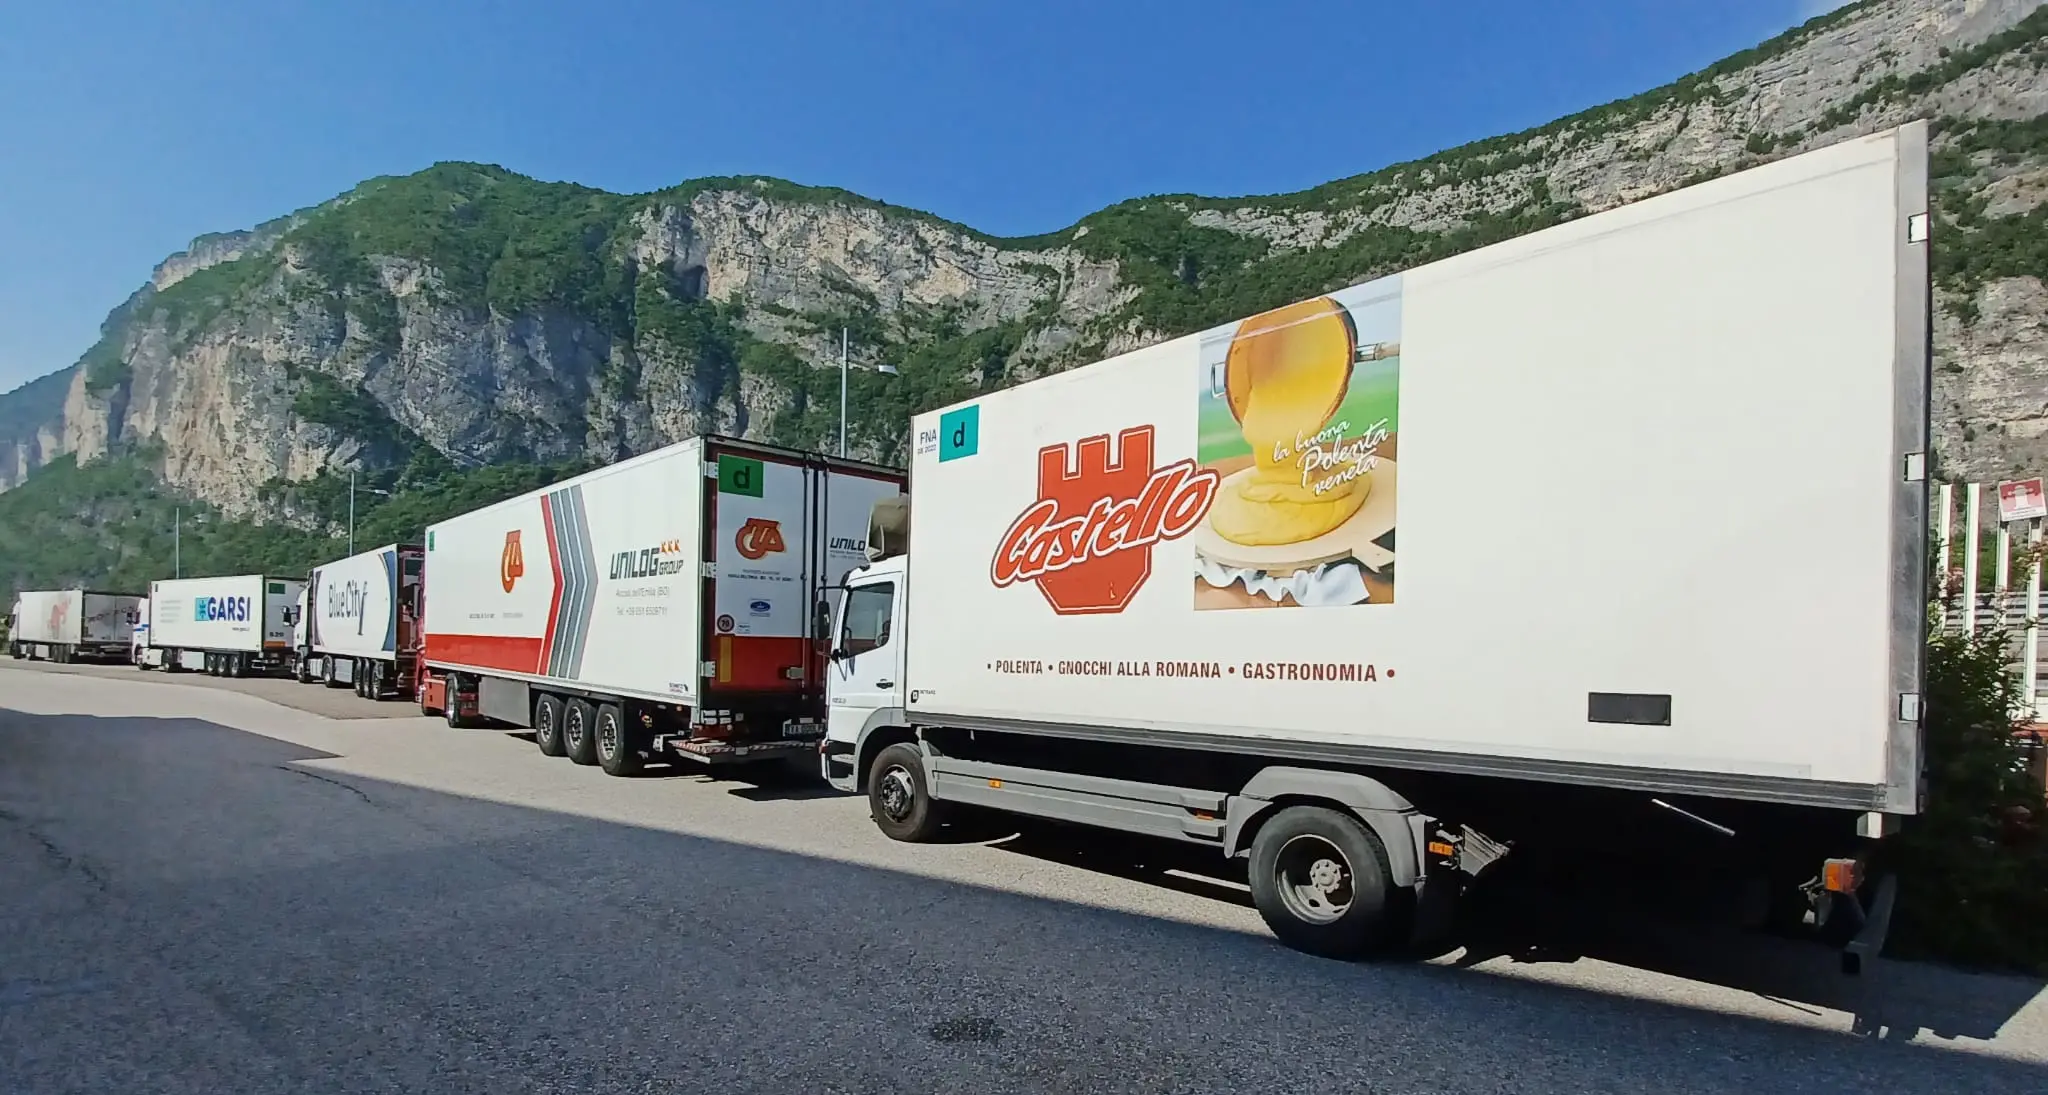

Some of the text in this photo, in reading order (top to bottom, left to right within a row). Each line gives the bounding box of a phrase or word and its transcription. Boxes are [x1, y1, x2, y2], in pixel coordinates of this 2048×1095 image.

[920, 428, 937, 445] FNA
[953, 421, 966, 448] d
[1272, 429, 1350, 462] la buona
[1297, 418, 1389, 488] Polenta
[732, 465, 751, 490] d
[1313, 447, 1378, 496] veneta
[989, 459, 1220, 587] Castello
[829, 537, 866, 551] UNILO
[609, 548, 684, 580] UNILOG GROUP
[207, 596, 251, 621] GARSI
[996, 660, 1377, 682] POLENTA GNOCCHI ALLA ROMANA GASTRONOMIA
